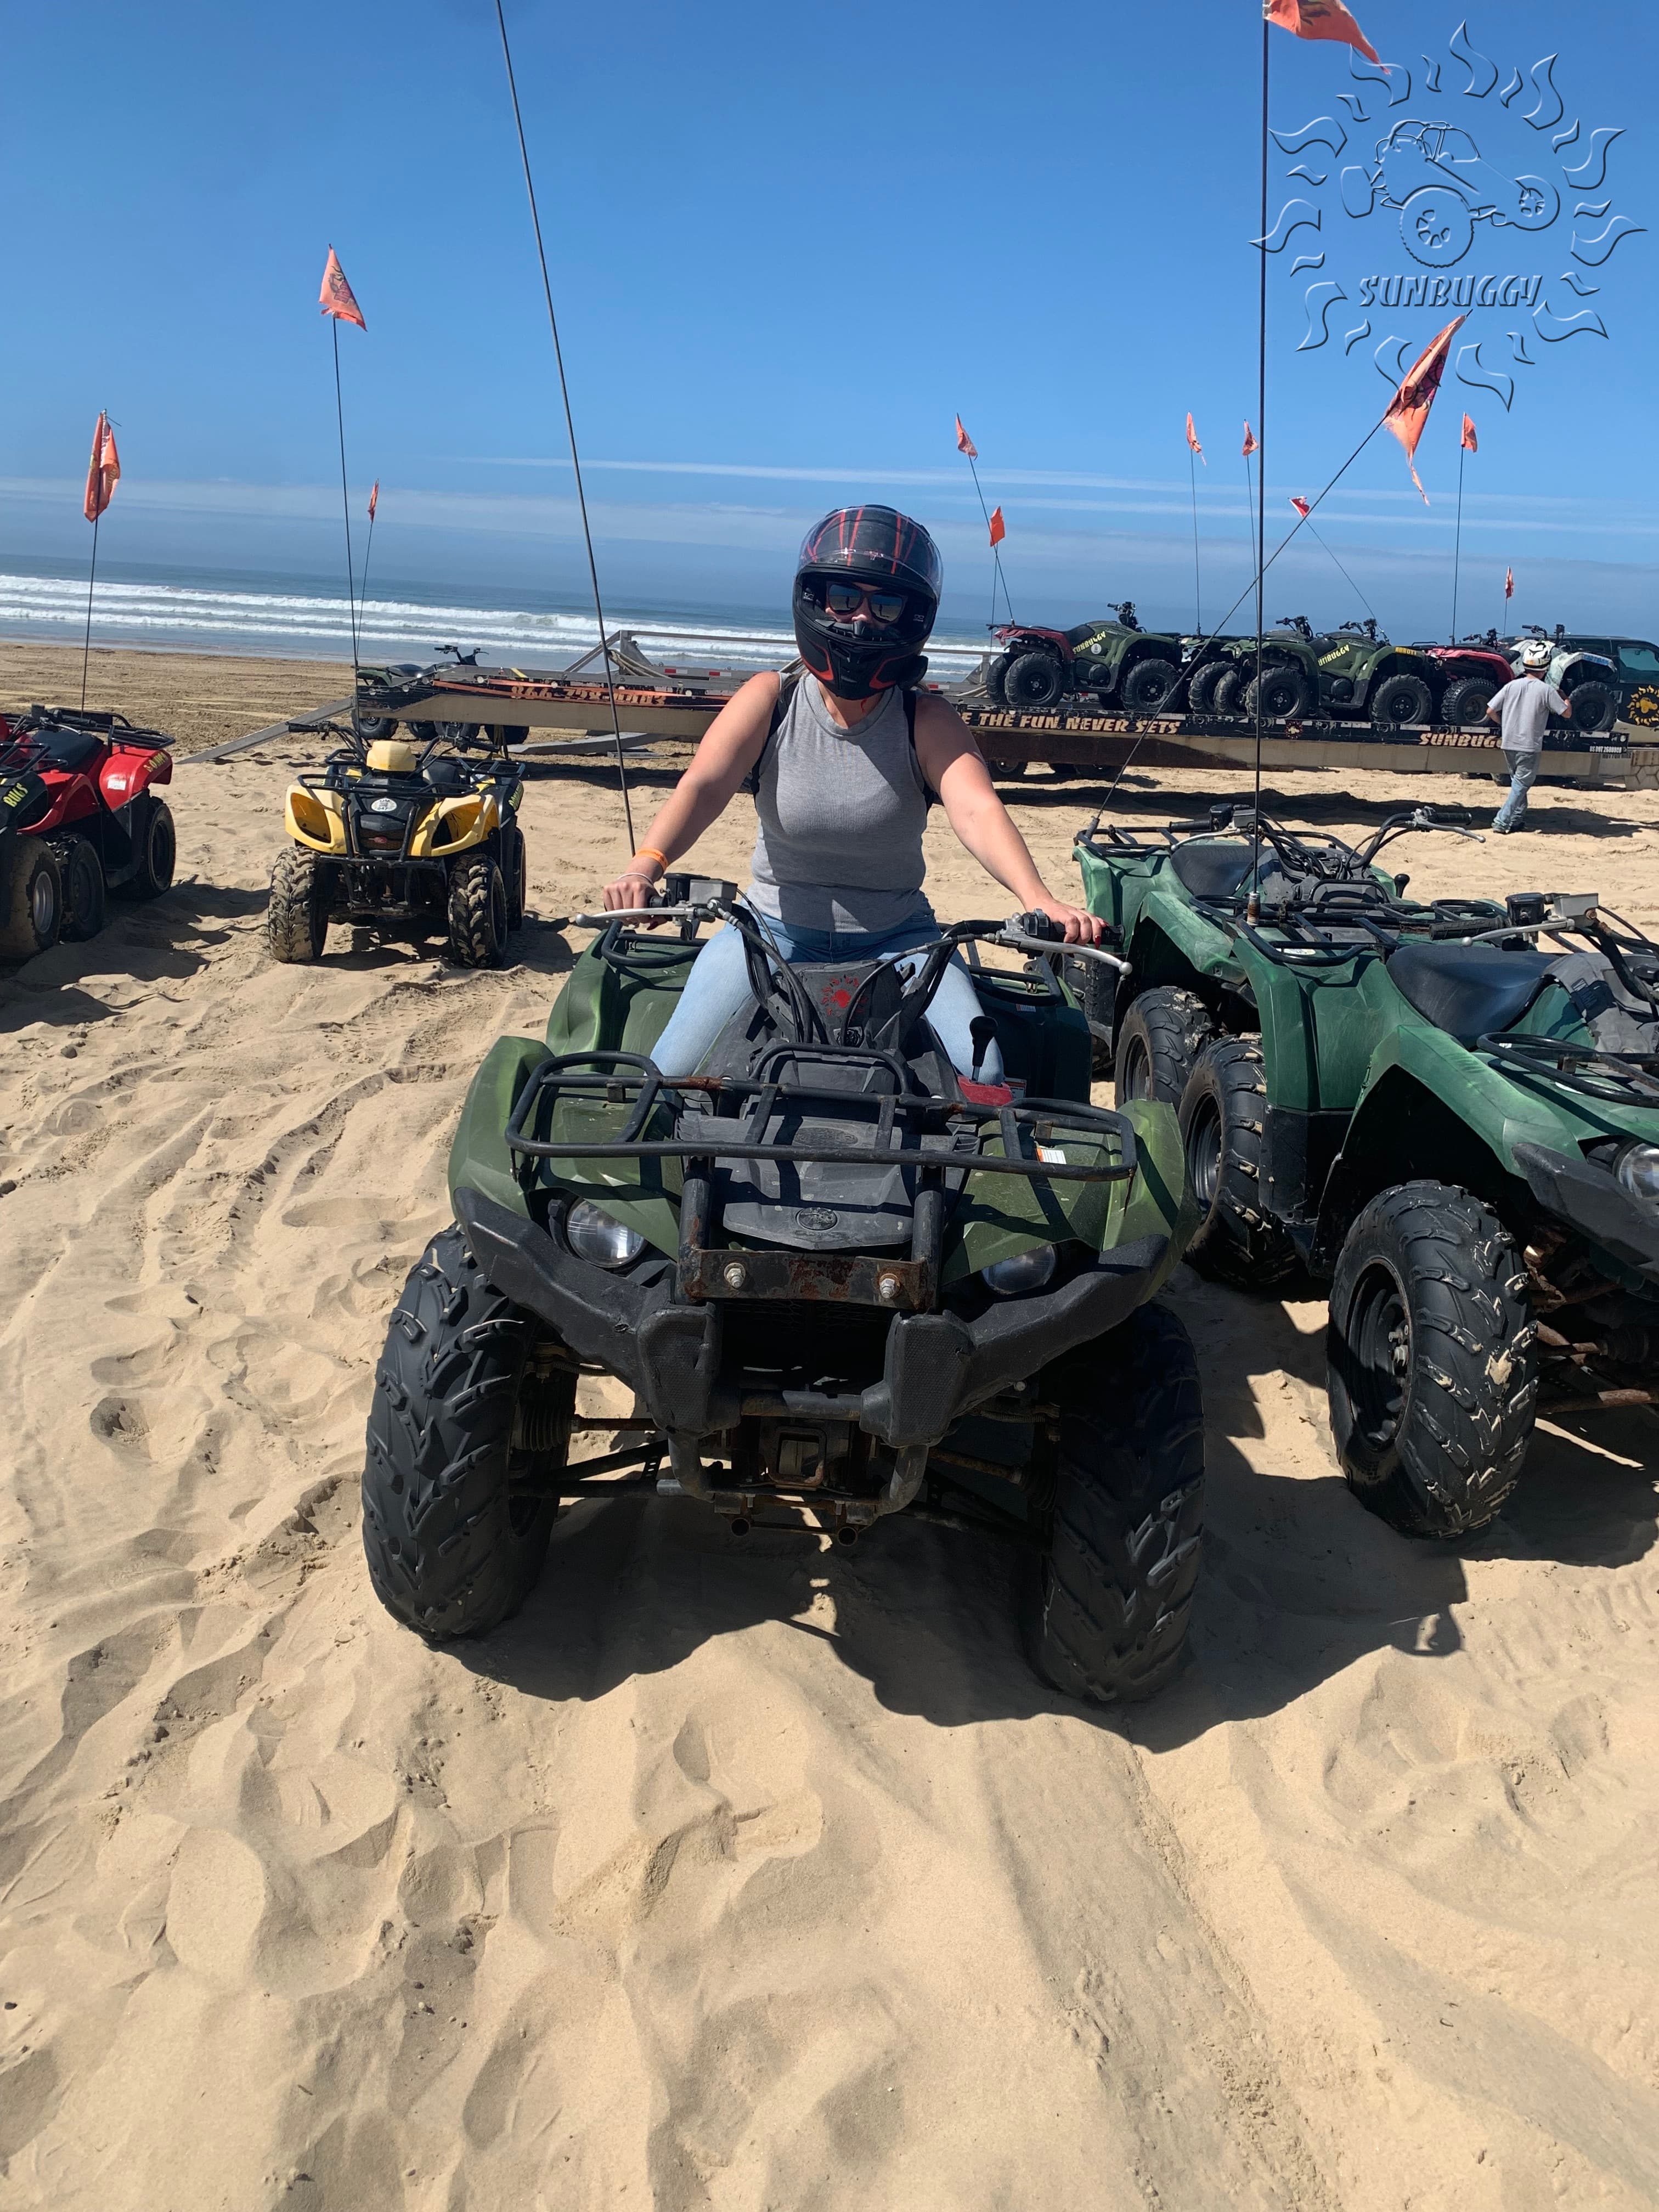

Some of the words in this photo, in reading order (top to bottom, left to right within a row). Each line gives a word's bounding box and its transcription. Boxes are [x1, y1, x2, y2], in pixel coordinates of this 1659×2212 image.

[979, 713, 1015, 727] THE
[1019, 715, 1060, 729] FUN
[1065, 718, 1127, 732] NEVER
[1135, 720, 1181, 734] SETS
[1418, 732, 1503, 748] SUNBUG
[3, 782, 28, 807] BUGS
